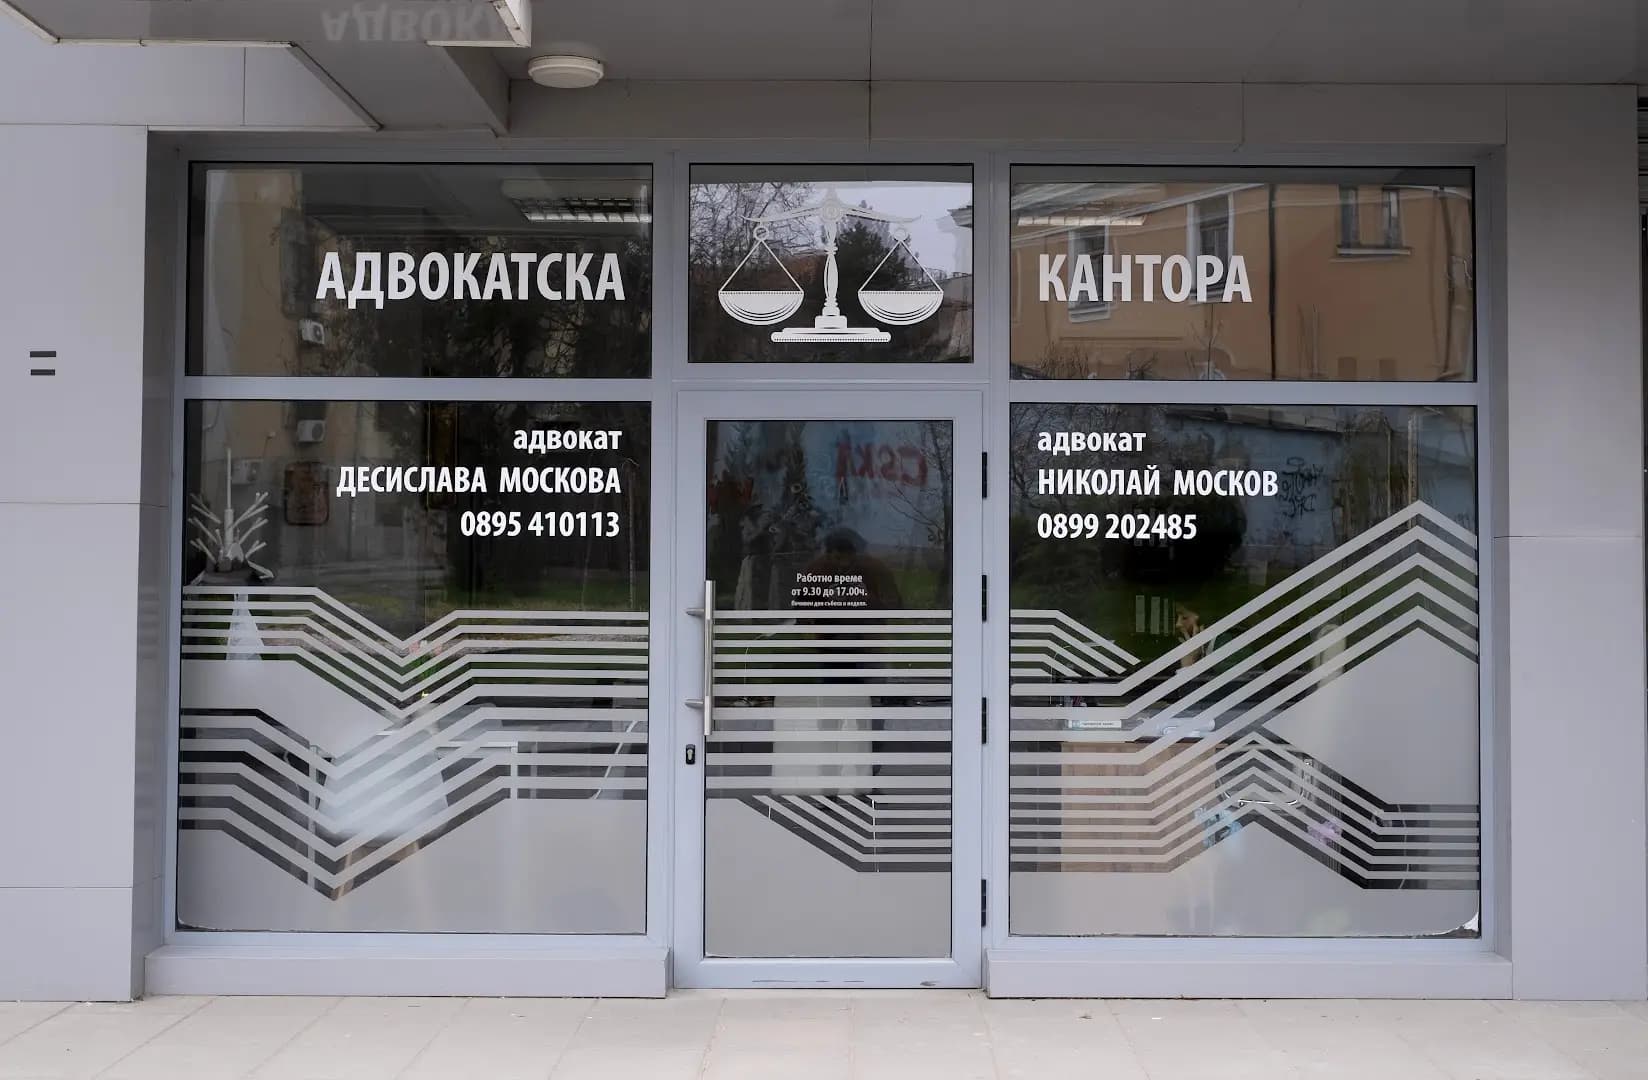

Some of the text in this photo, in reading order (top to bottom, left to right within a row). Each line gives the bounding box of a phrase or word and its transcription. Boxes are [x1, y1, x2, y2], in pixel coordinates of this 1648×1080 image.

[316, 251, 625, 309] АДВОКАТСКА
[1038, 253, 1253, 304] КАНТОРА
[513, 429, 623, 455] адвокат
[1037, 431, 1147, 457] адвокат
[335, 465, 622, 498] ДЕСИСЛАВА МОСКОВА
[1037, 464, 1161, 497] НИКОЛАЙ
[1172, 469, 1279, 498] МОСКОВ
[459, 510, 621, 538] 0895 410113
[1037, 512, 1198, 540] 0899 202485
[791, 586, 868, 598] от 9.30 до 17.00ч.
[796, 572, 863, 585] Работно време
